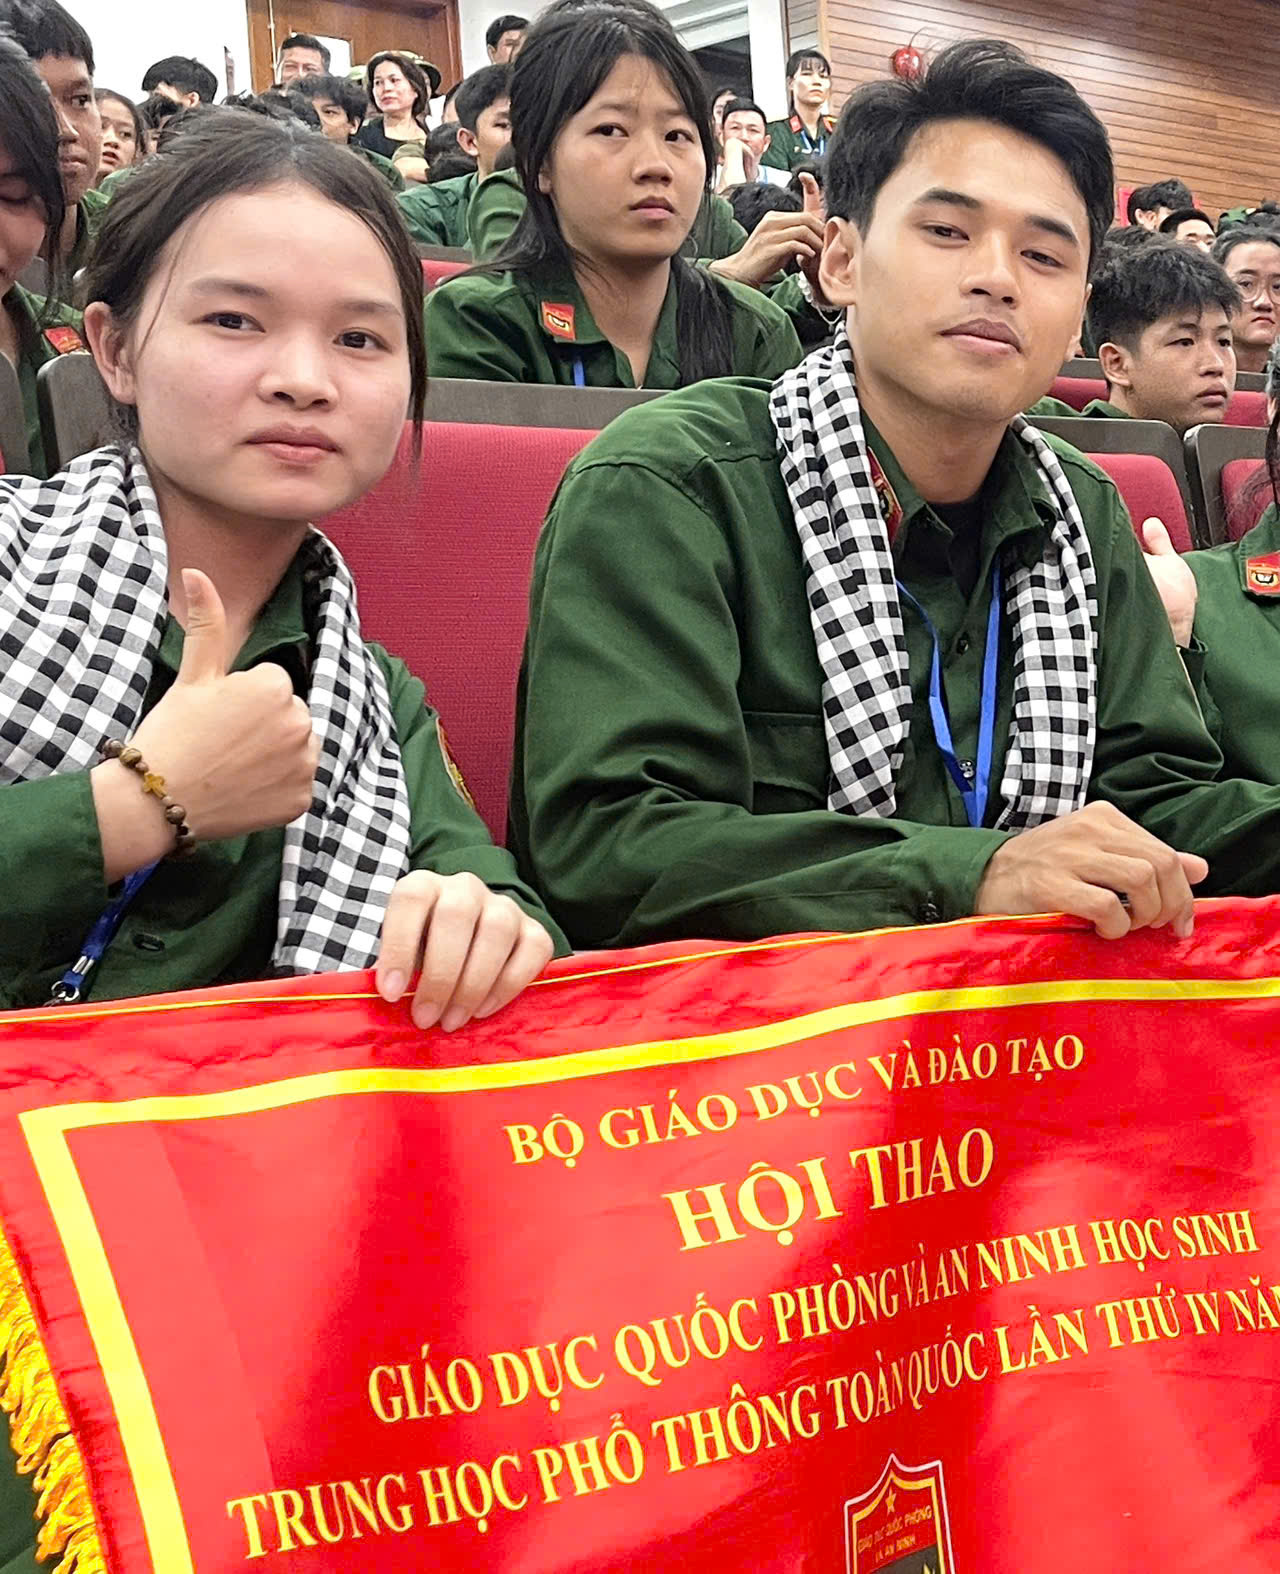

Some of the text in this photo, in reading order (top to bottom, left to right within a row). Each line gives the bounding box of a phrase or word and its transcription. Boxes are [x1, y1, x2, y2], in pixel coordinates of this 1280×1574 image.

[504, 1034, 1083, 1168] BỘ GIÁO DỤC VÀ ĐÀO TẠO
[661, 1127, 995, 1251] HỘI THAO
[369, 1210, 1259, 1422] GIÁO DỤC QUỐC PHÒNG VÀ AN NINH HỌC SINH
[226, 1475, 412, 1559] TRUNG
[419, 1456, 527, 1532] HỌC
[532, 1414, 644, 1503] PHỔ
[652, 1383, 819, 1472] THÔNG
[827, 1352, 902, 1428] TOÀN
[906, 1321, 988, 1410] QUỐC
[994, 1305, 1088, 1373] LẦN
[1095, 1283, 1180, 1348] THỨ
[1184, 1292, 1221, 1335] IV
